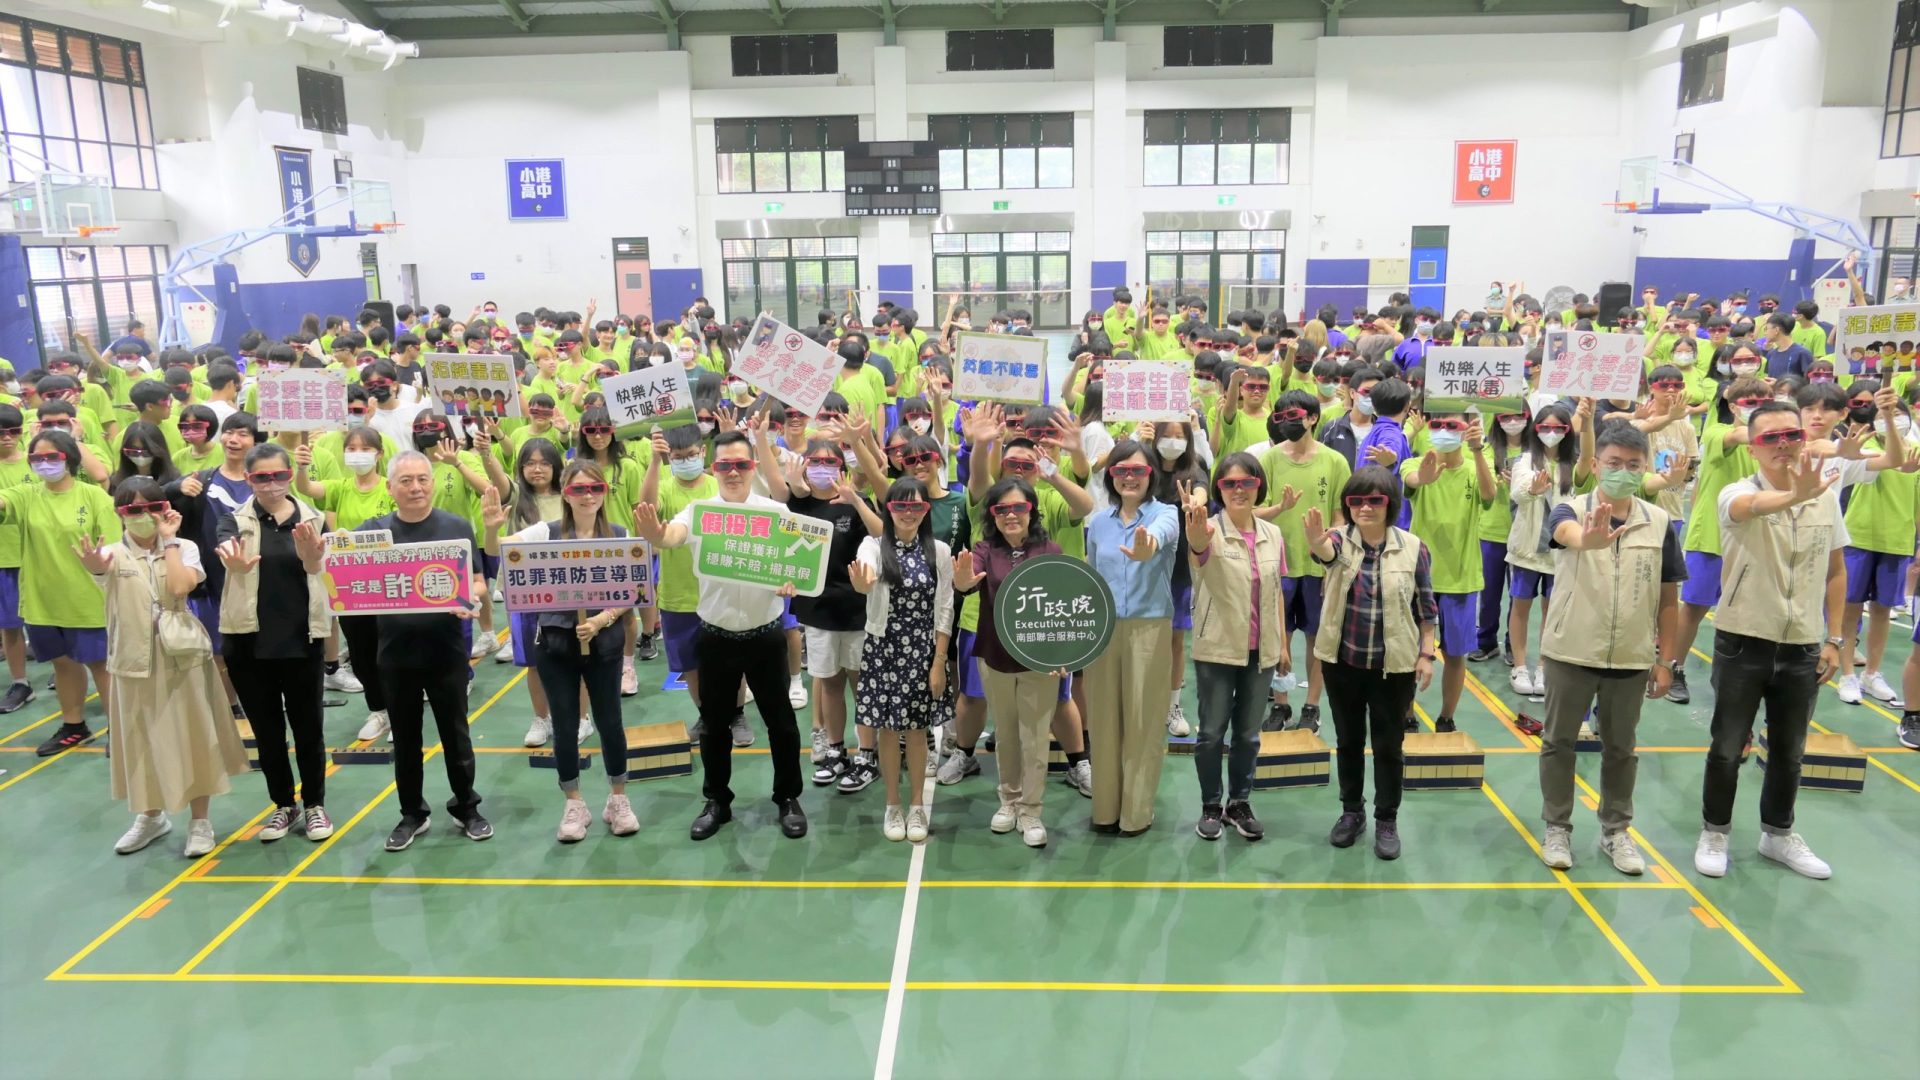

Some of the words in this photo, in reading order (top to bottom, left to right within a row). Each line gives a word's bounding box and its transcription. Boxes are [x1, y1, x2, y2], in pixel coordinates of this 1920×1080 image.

[1468, 148, 1504, 166] 小港
[520, 167, 552, 183] 小港
[1467, 165, 1502, 182] 高中
[520, 183, 552, 199] 高中
[1845, 312, 1920, 335] 拒絕毒
[1439, 360, 1511, 377] 快樂人生
[258, 380, 345, 400] 珍愛生命
[615, 376, 678, 404] 快樂人生
[1106, 371, 1189, 391] 珍愛生命
[1444, 379, 1500, 395] 不吸毒
[261, 399, 345, 419] 遠離毒品
[624, 395, 673, 421] 不吸毒
[1107, 390, 1189, 411] 遠離毒品
[701, 511, 772, 538] 假投資
[724, 538, 780, 559] 保證獲利
[329, 551, 369, 567] ATM
[508, 564, 647, 586] 犯罪預防宣導團
[528, 592, 553, 604] 110
[606, 590, 630, 601] 165
[1015, 586, 1095, 618] 行政院
[1015, 619, 1066, 629] Executive
[1069, 618, 1096, 627] Yuan
[1016, 631, 1097, 643] 南部聯合服務中心
